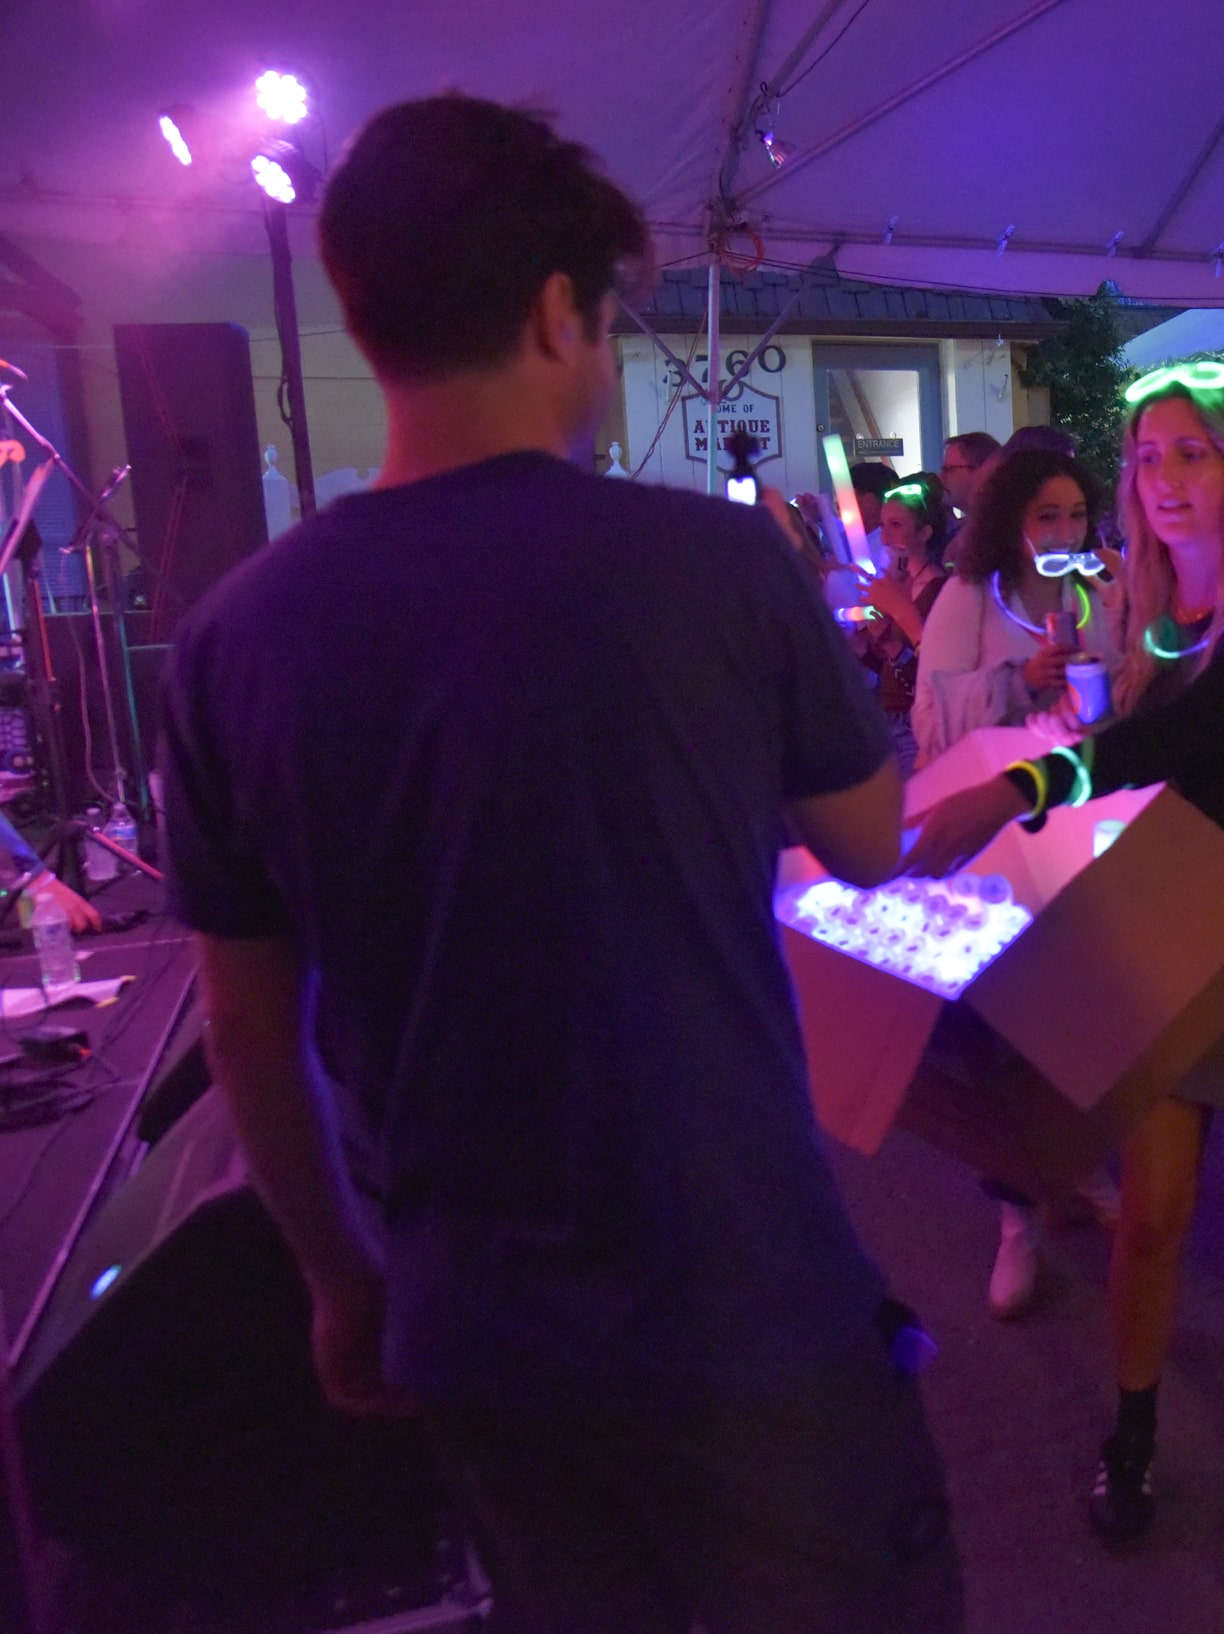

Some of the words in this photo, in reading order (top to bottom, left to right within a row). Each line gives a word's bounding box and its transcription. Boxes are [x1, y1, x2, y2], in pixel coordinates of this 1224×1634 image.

[743, 404, 755, 413] OF
[693, 419, 770, 433] ATIQUE
[857, 440, 900, 448] ENTRANCE
